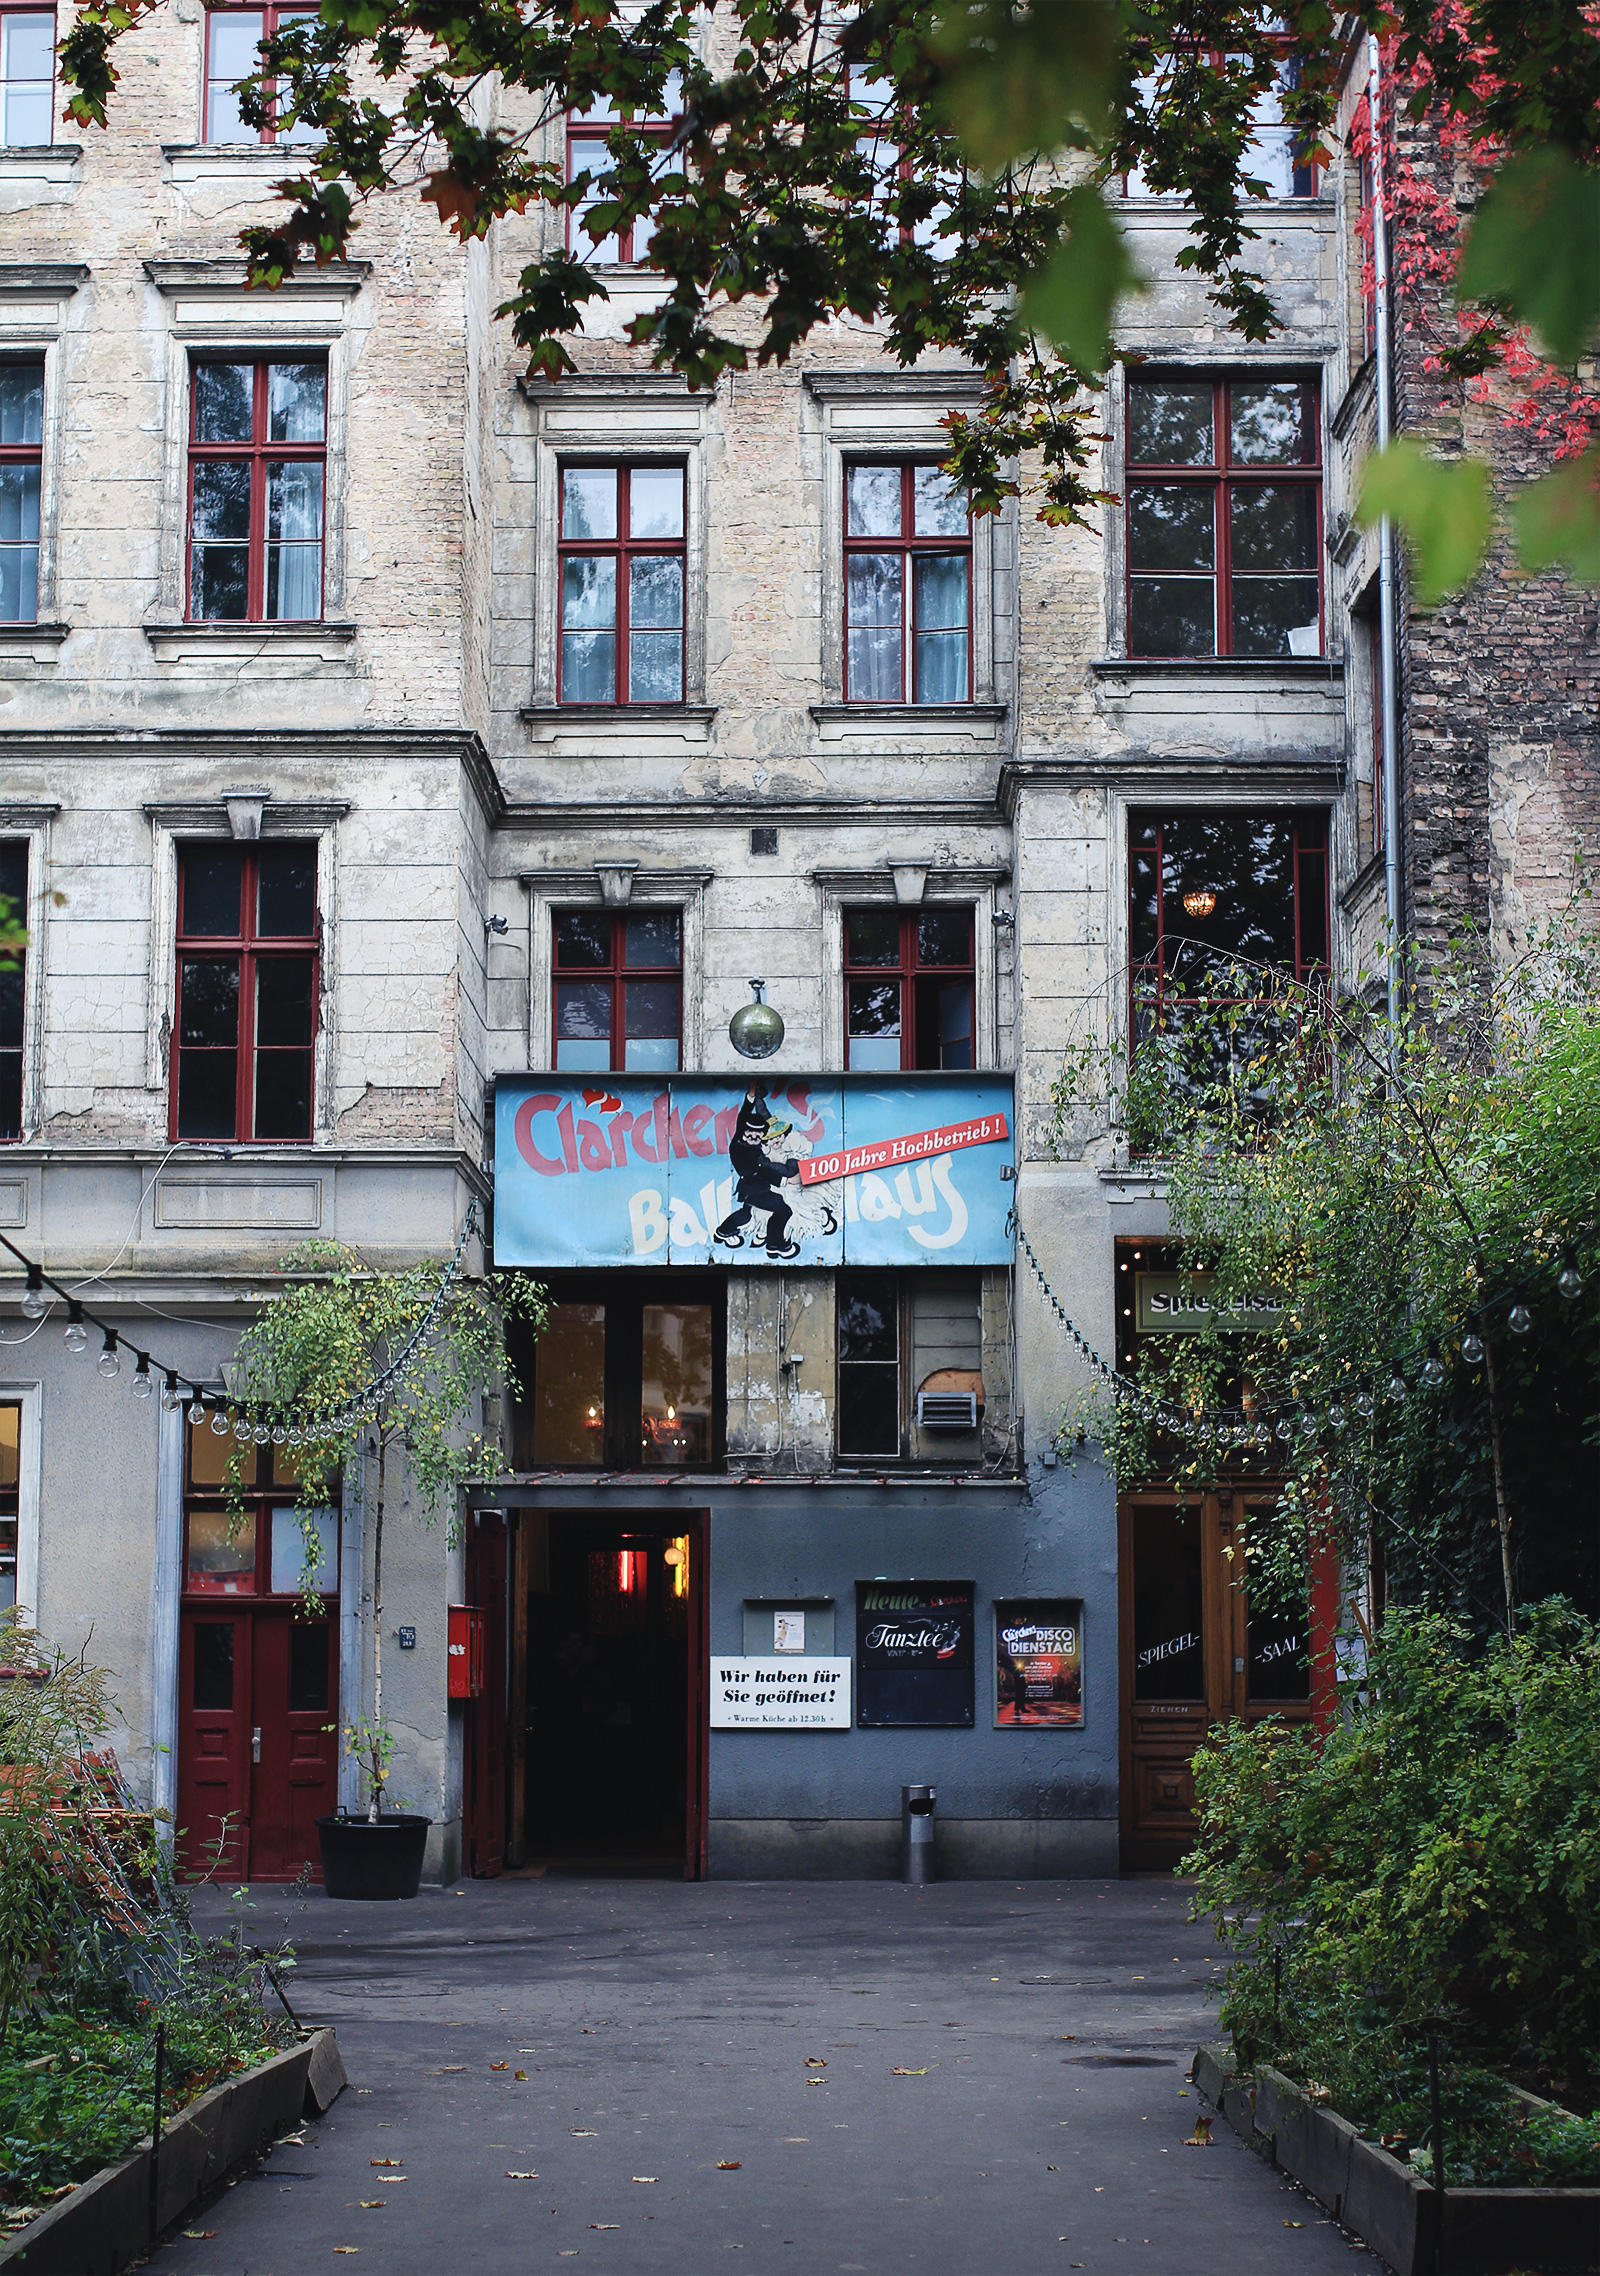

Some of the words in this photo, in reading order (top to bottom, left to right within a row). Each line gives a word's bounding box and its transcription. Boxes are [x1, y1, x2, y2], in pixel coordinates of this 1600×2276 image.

[808, 1157, 840, 1178] 100
[842, 1149, 887, 1174] Jahre
[890, 1121, 990, 1160] Hochbetrieb
[629, 1153, 968, 1255] Ballaus
[864, 1589, 919, 1610] Heute
[865, 1624, 944, 1649] Tanztee
[1036, 1630, 1073, 1642] DISCO
[1010, 1640, 1073, 1654] DIENSTAG
[1137, 1632, 1200, 1668] SPIEGEL-
[1254, 1635, 1301, 1663] -SAAL
[720, 1670, 750, 1683] Wir
[755, 1670, 808, 1683] haben
[814, 1670, 841, 1684] für
[723, 1689, 751, 1703] Sie
[755, 1689, 836, 1706] geöffnet!
[733, 1714, 760, 1722] Warme
[762, 1714, 786, 1722] Küche
[788, 1714, 798, 1722] ab
